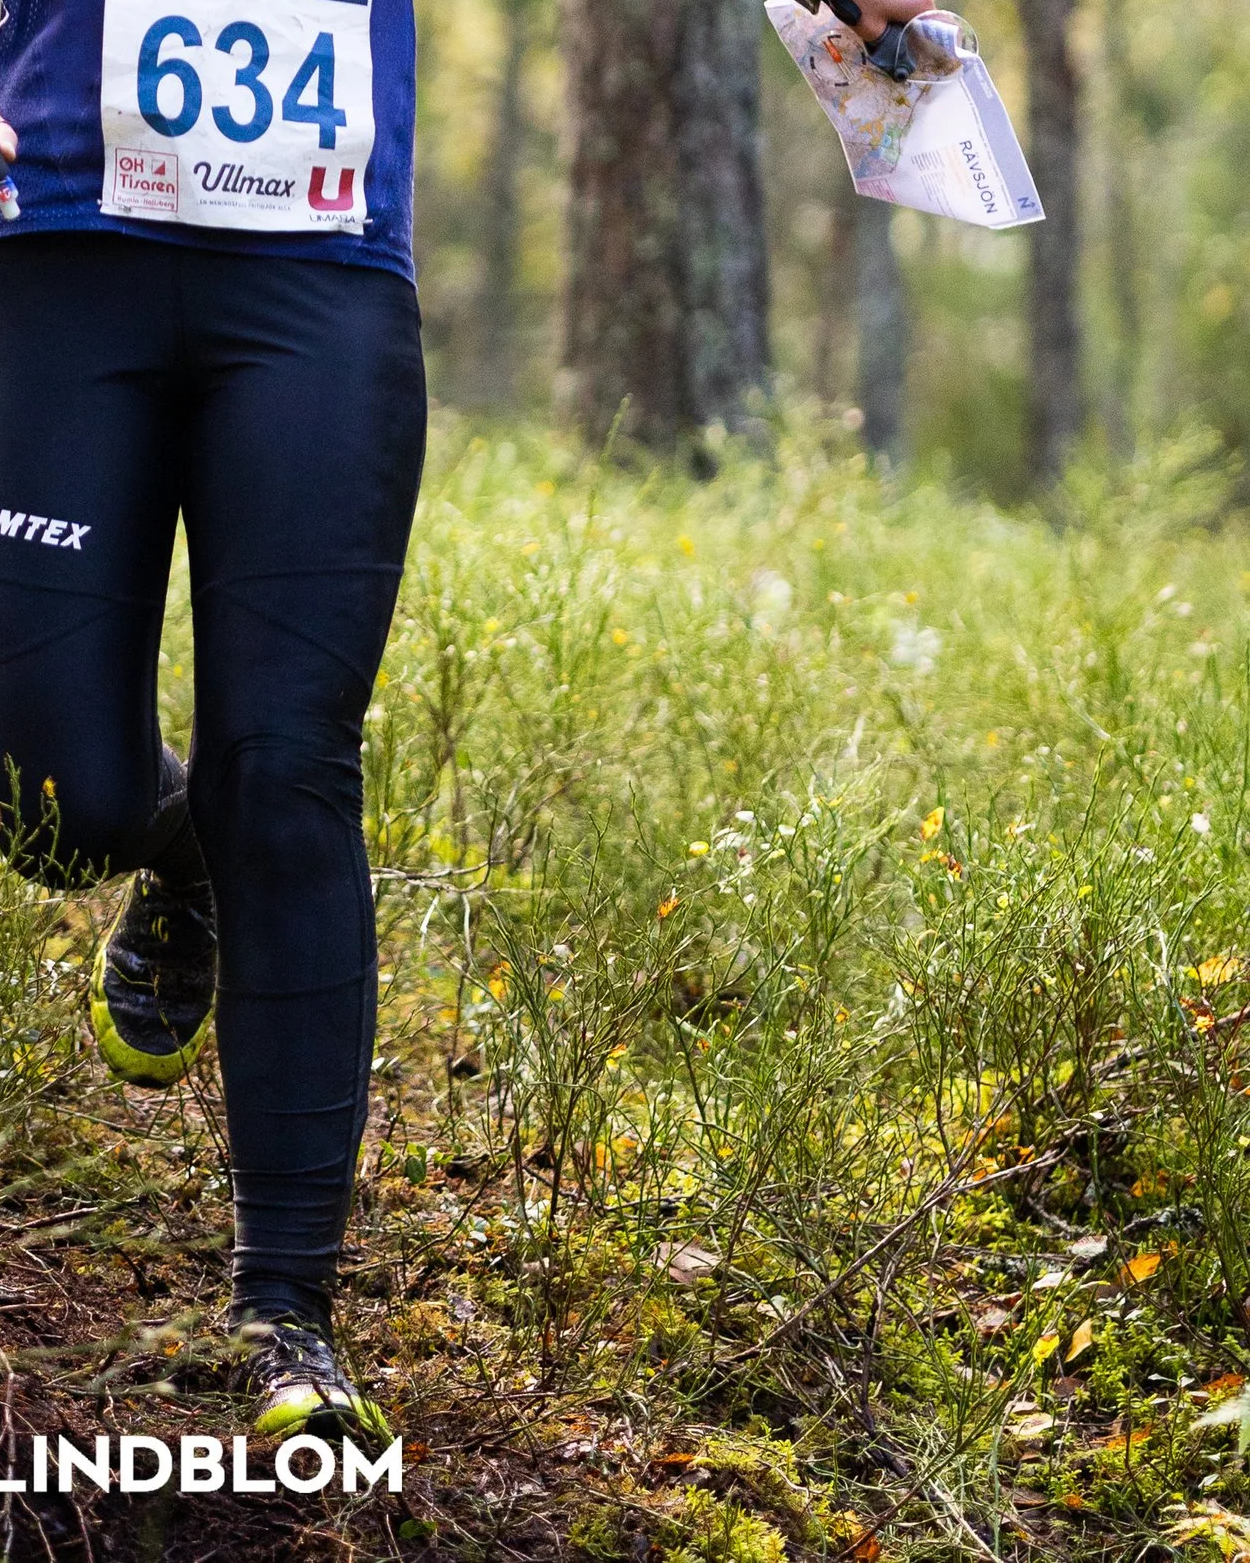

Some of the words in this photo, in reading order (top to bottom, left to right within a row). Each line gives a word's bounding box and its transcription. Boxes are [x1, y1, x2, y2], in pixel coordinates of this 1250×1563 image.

[137, 15, 347, 150] 634
[119, 173, 175, 194] Tisaren
[193, 161, 296, 198] Ullmax
[959, 139, 998, 214] RÄVSJÖN
